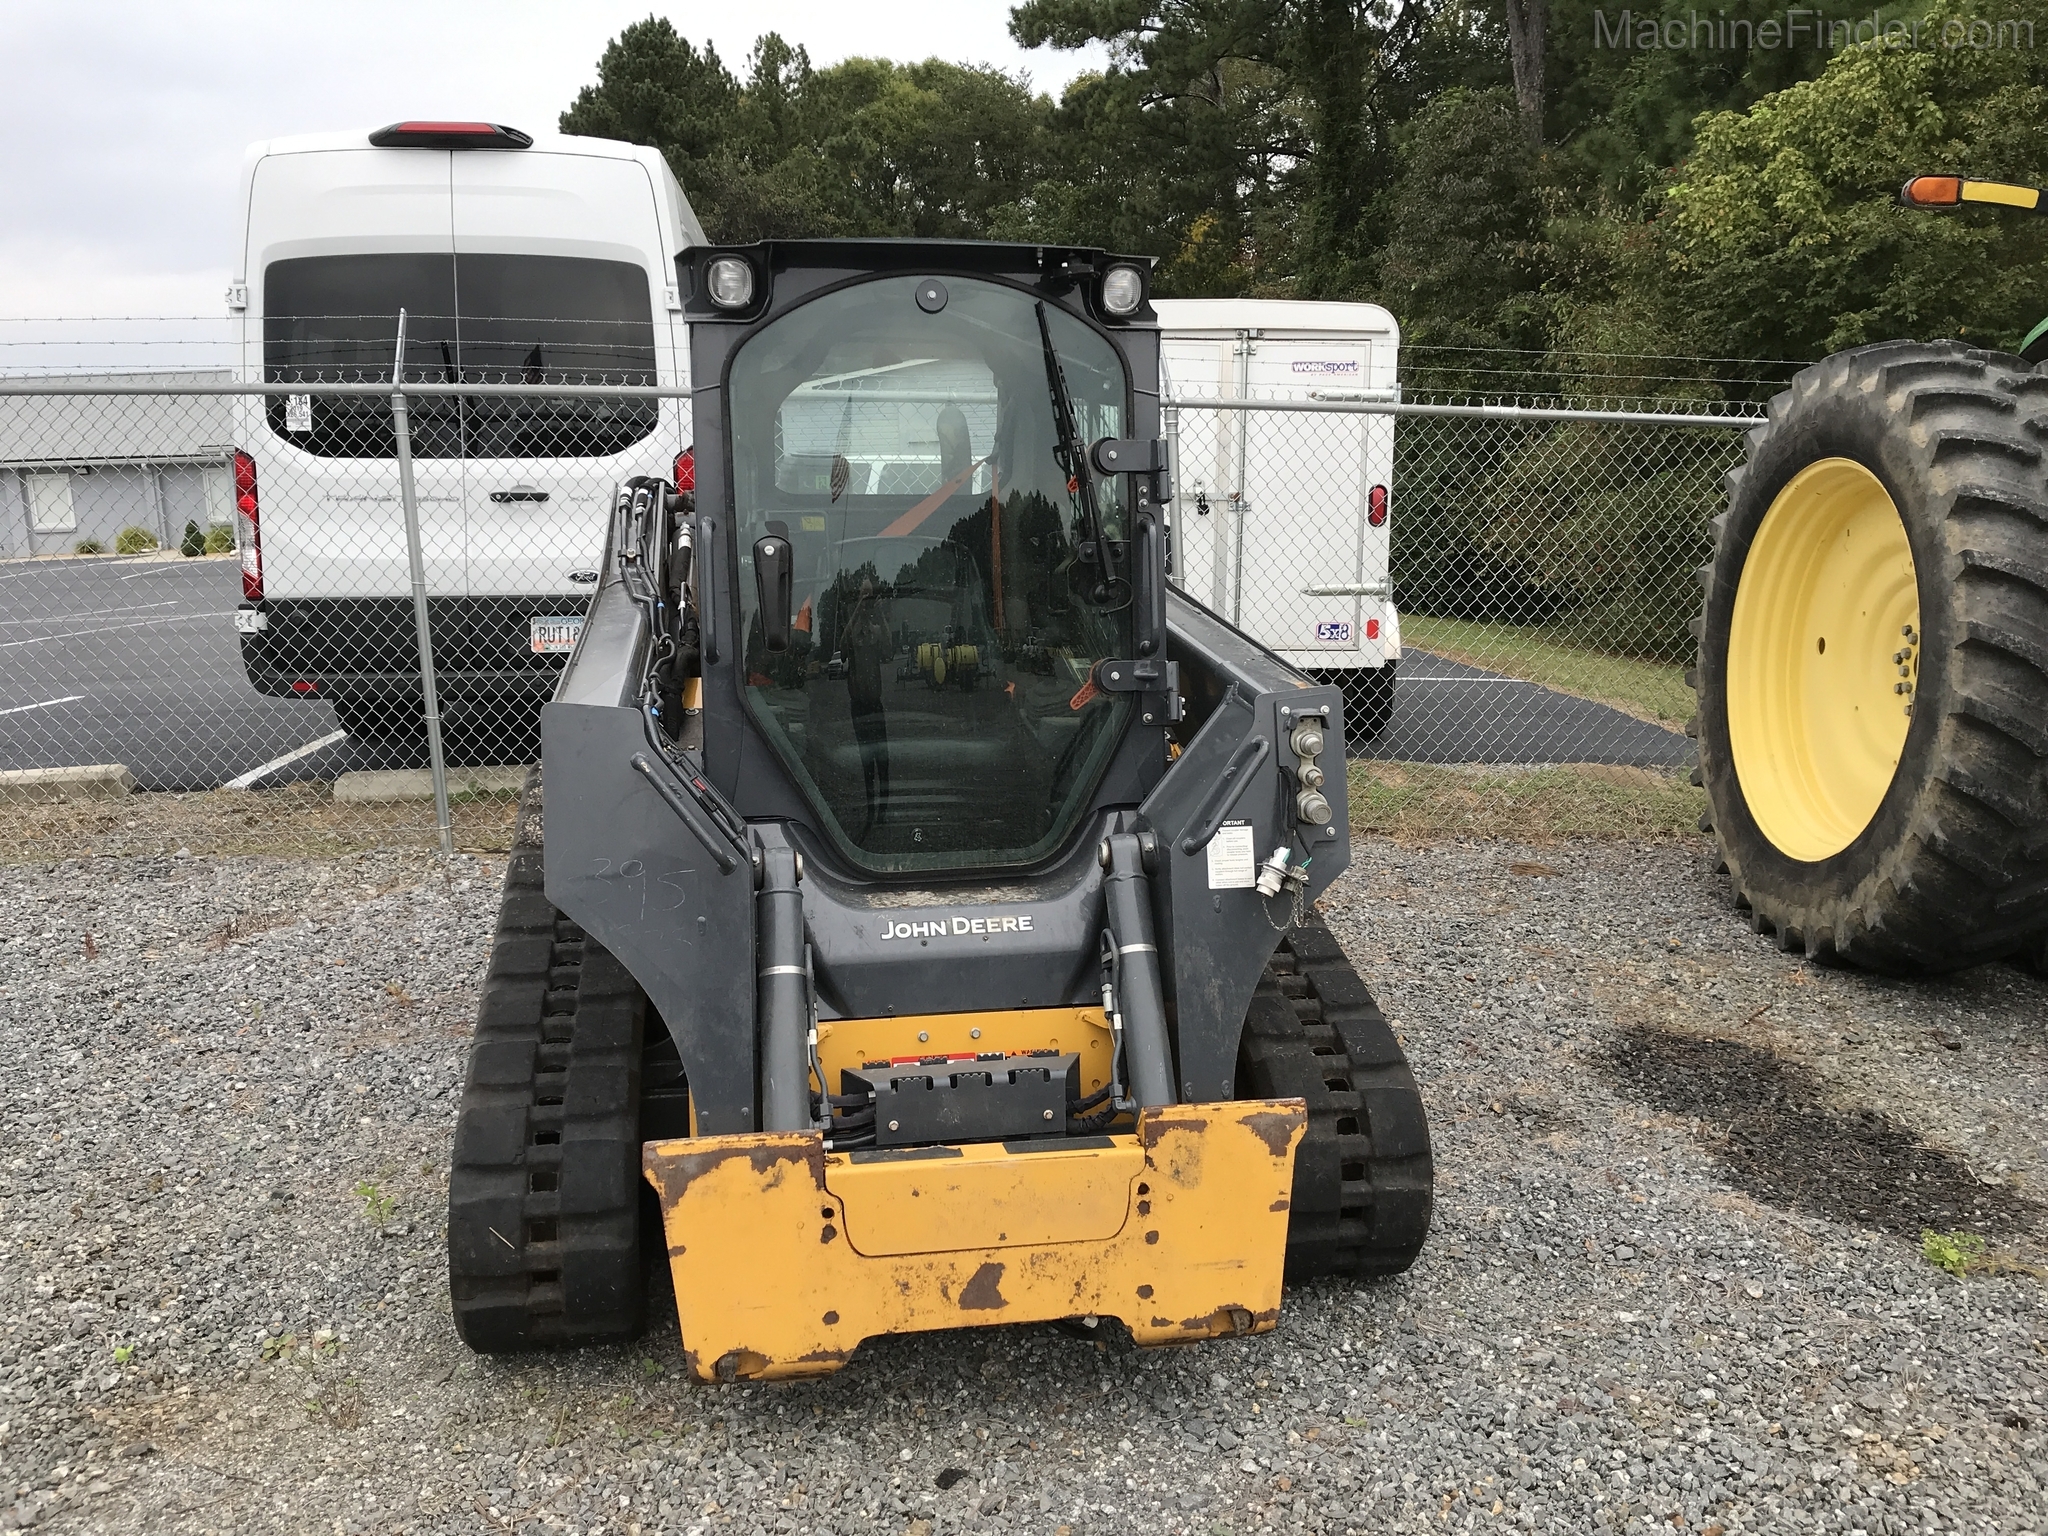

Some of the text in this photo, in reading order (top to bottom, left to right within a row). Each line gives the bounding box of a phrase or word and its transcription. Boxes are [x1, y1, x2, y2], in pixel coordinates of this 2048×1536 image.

[538, 626, 580, 643] RUT18
[881, 916, 1033, 940] JOHN DEERE
